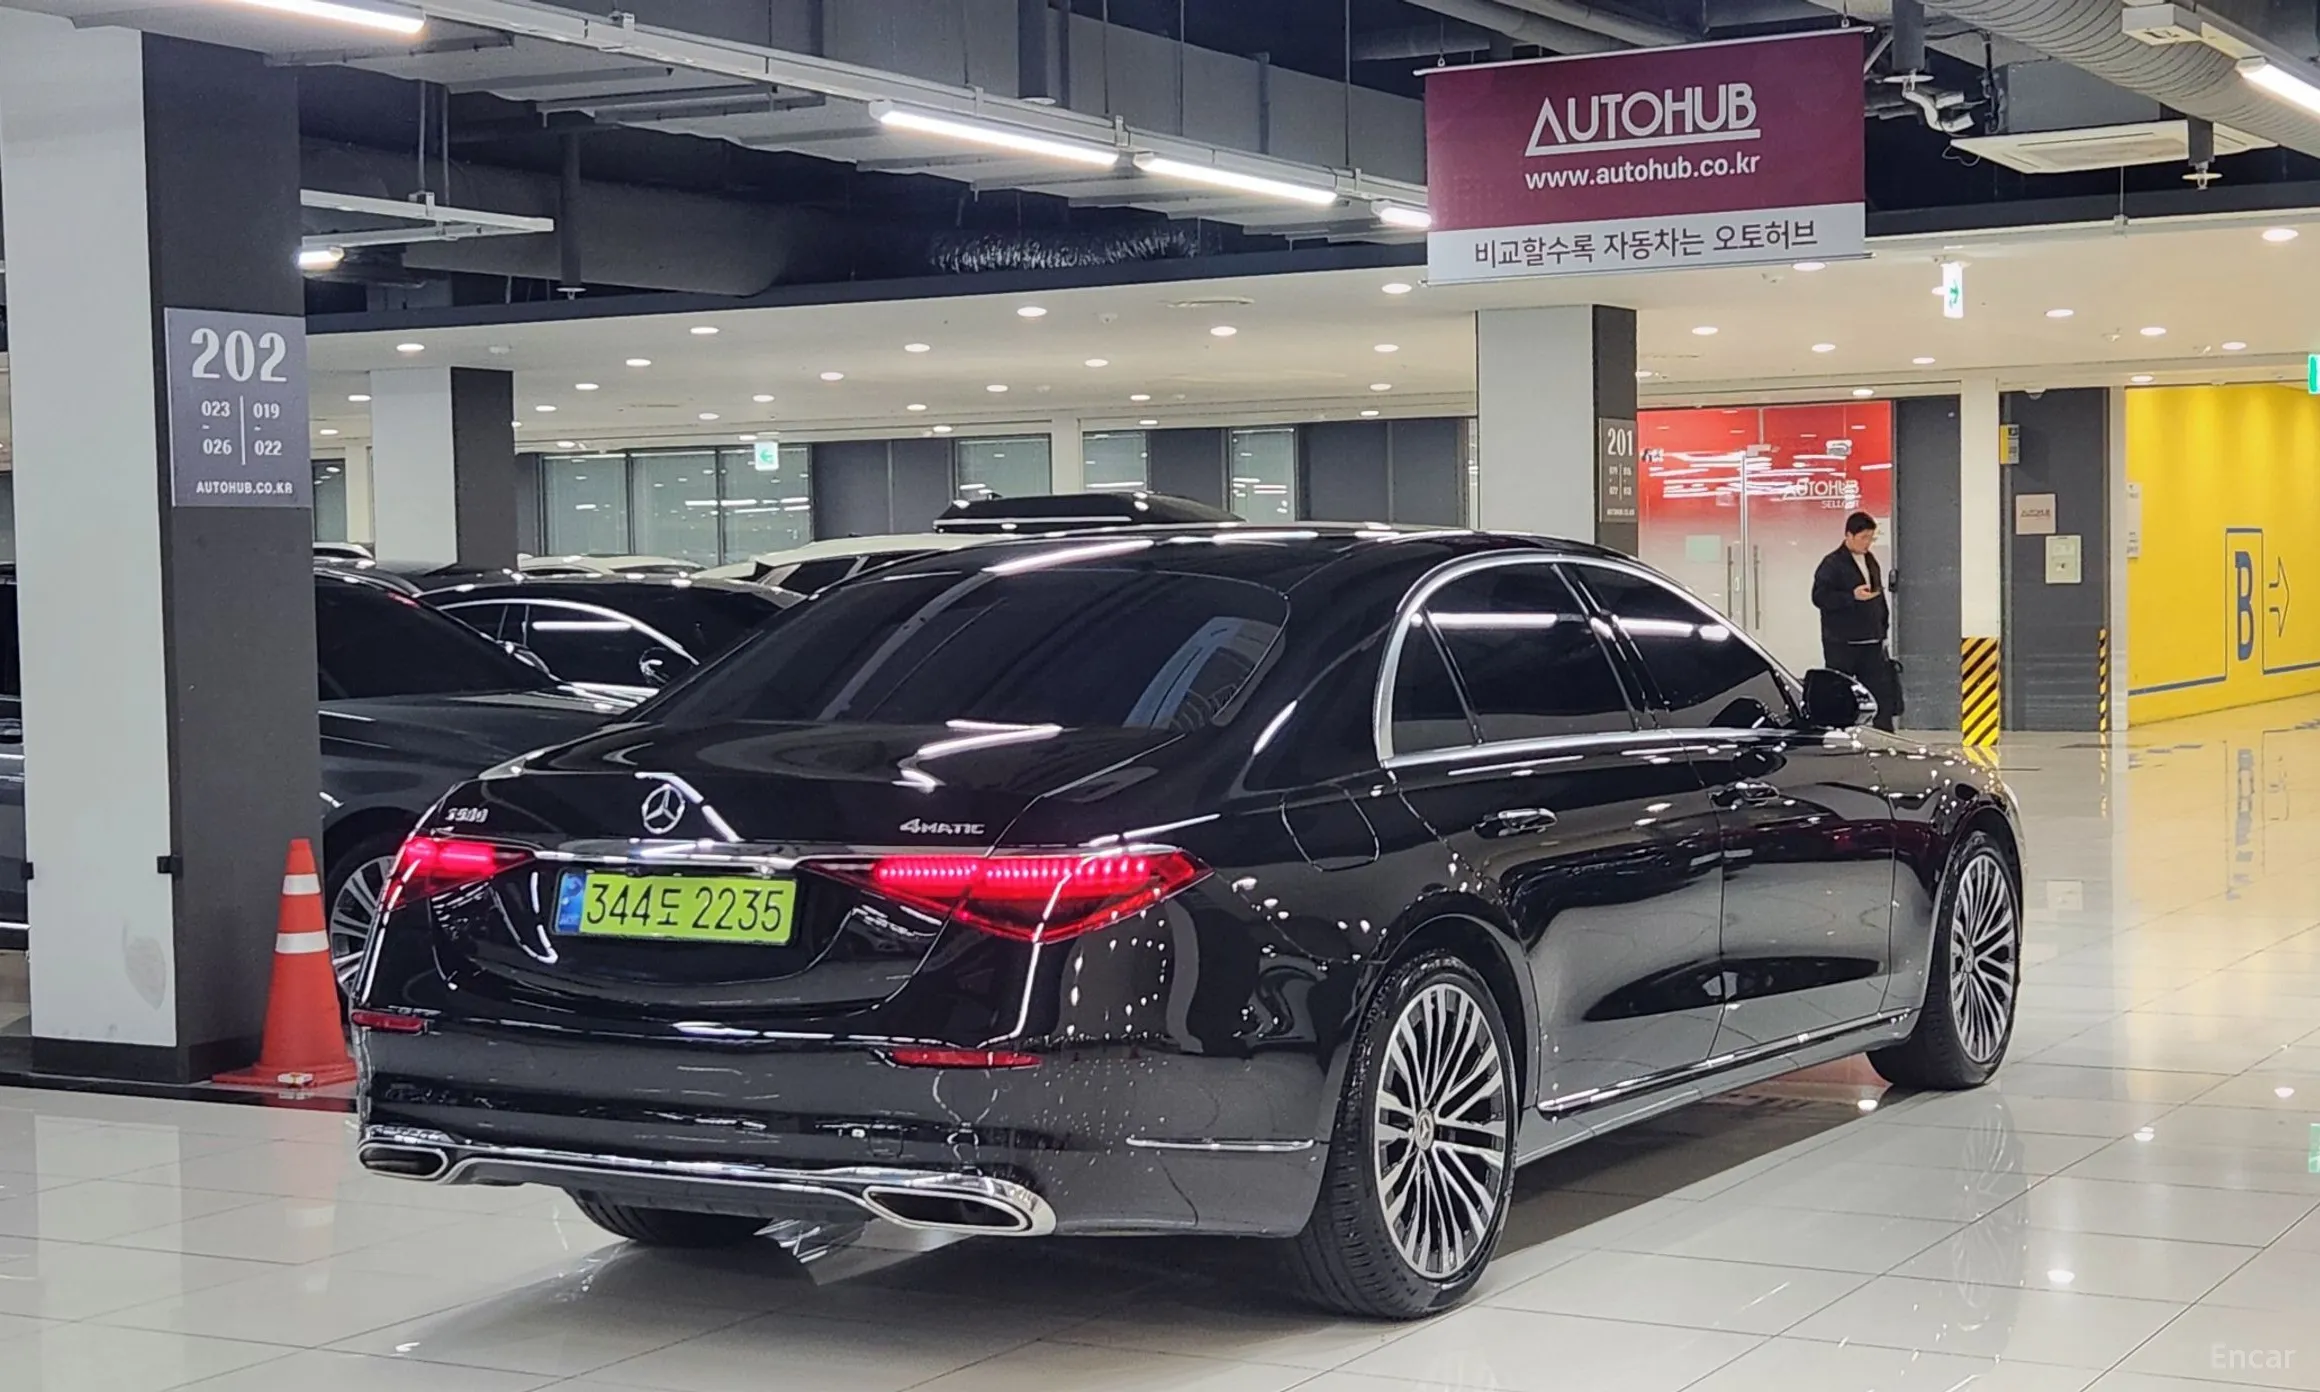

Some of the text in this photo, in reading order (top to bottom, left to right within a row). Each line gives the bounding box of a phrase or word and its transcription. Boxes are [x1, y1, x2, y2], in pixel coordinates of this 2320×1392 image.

[1525, 82, 1761, 157] AUTOHUB
[1525, 151, 1760, 191] www.autohub.co.kr
[1475, 219, 1818, 268] 비교할수록 자동차는 오토허브
[190, 327, 288, 383] 202
[201, 400, 231, 417] 023
[252, 402, 281, 419] 019
[203, 438, 233, 455] 026
[254, 440, 283, 456] 022
[1607, 427, 1634, 457] 201
[196, 481, 294, 495] AUTOHUB.CO.KR
[2235, 551, 2254, 661] B
[899, 818, 985, 834] 4MATIC
[586, 883, 784, 932] 344도 2235
